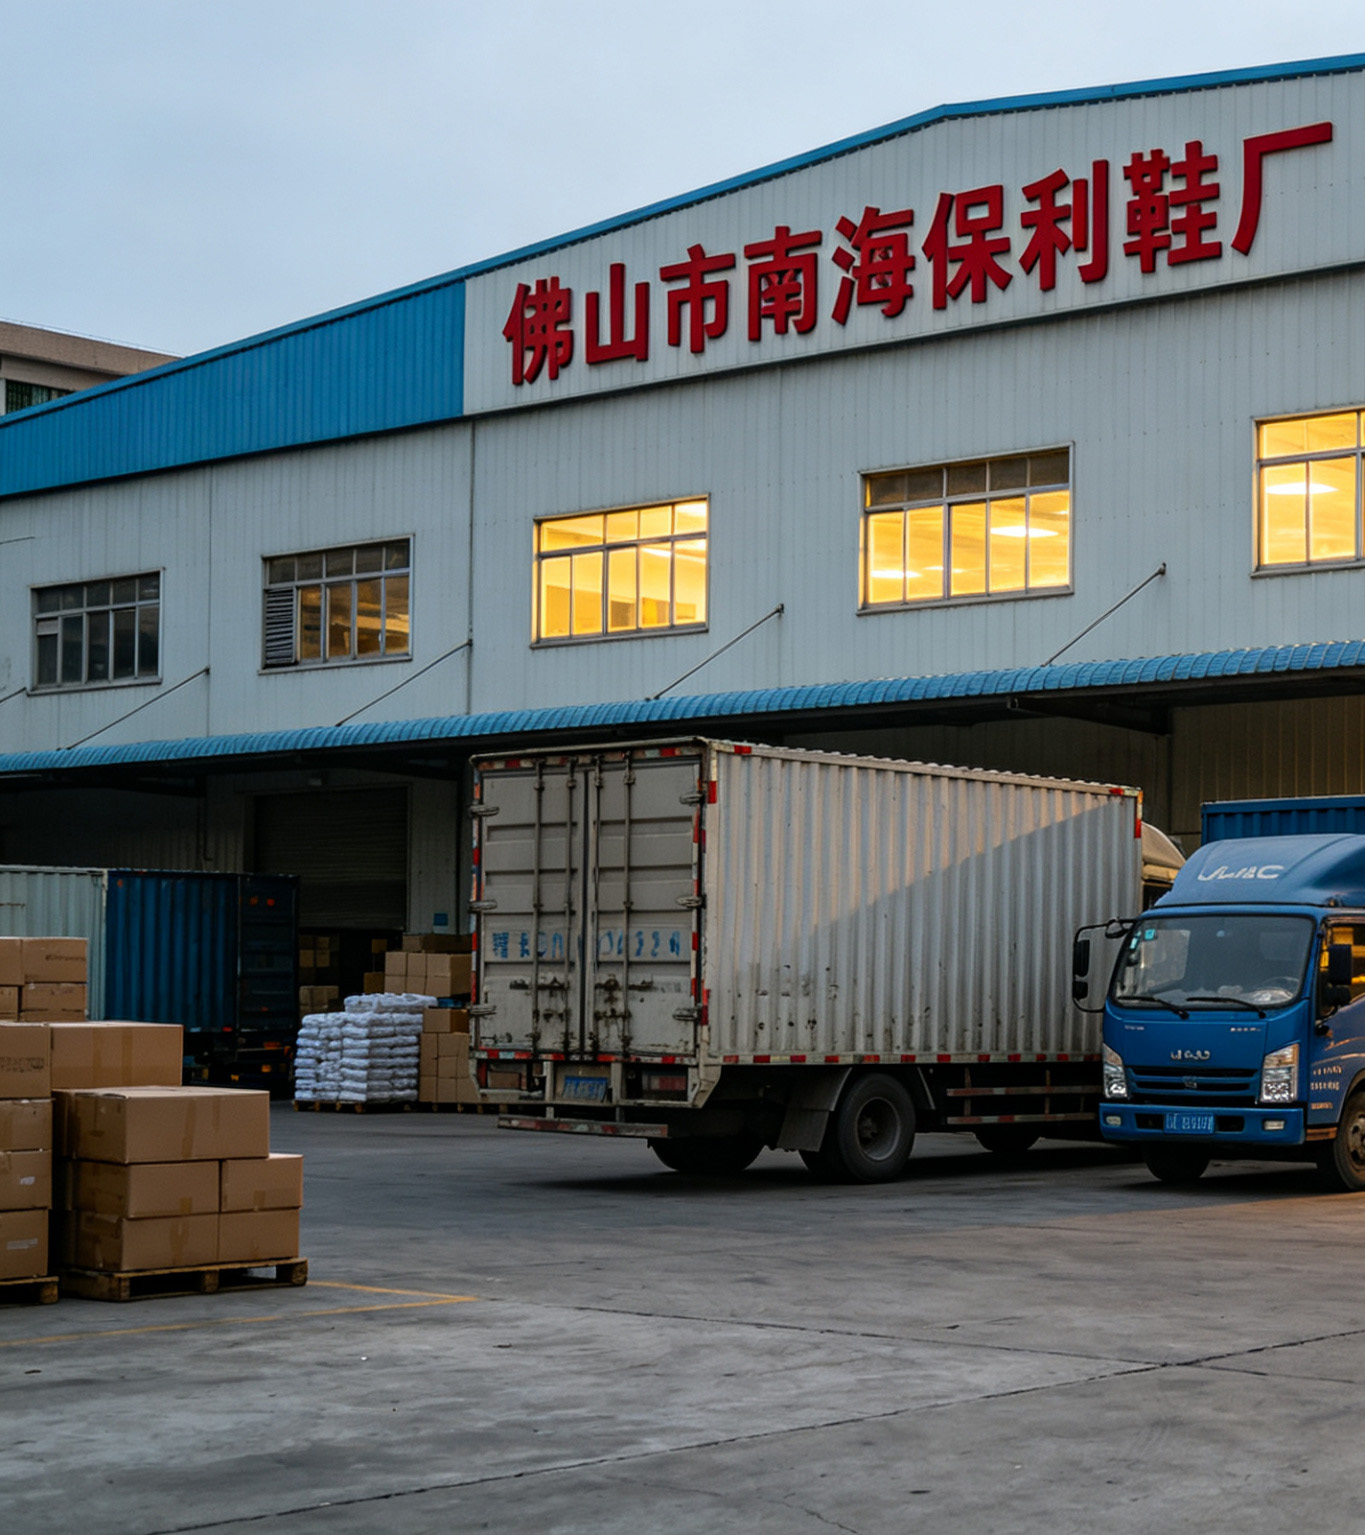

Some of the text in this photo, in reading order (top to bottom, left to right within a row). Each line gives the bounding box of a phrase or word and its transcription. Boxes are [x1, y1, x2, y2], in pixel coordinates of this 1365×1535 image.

[502, 121, 1334, 385] 佛山市南海保利鞋厂
